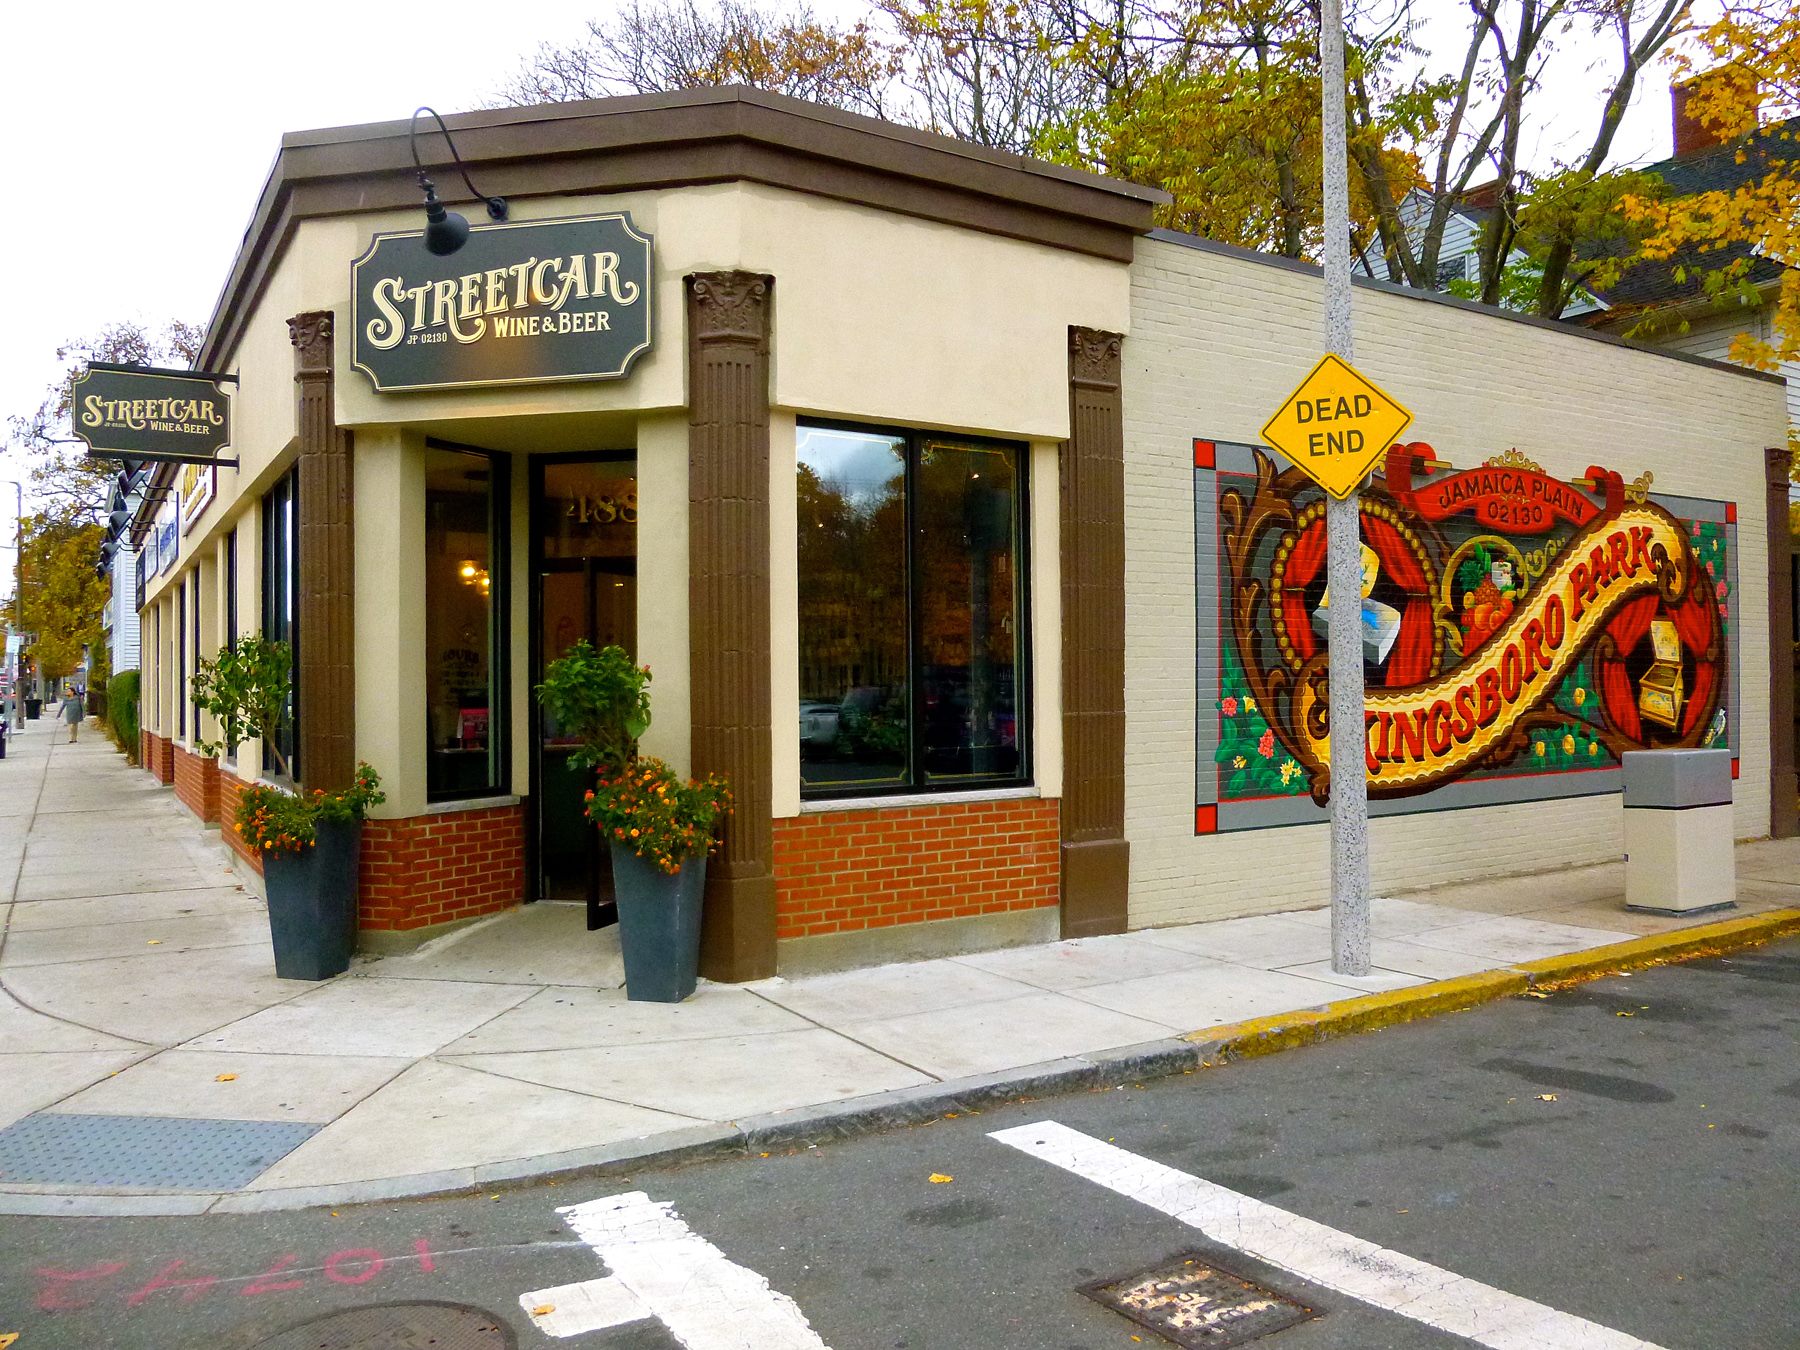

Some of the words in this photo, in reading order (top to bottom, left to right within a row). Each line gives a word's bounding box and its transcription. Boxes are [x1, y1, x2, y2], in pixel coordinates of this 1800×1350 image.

[366, 251, 640, 350] STREETCAR
[421, 332, 448, 344] 02130
[82, 395, 225, 430] STREETCAR
[1296, 394, 1372, 424] DEAD
[1308, 429, 1365, 457] END
[1439, 473, 1527, 509] JAMAICA
[1532, 478, 1584, 520] PLAIN
[1488, 501, 1543, 525] 02130
[1569, 526, 1657, 622] PARK
